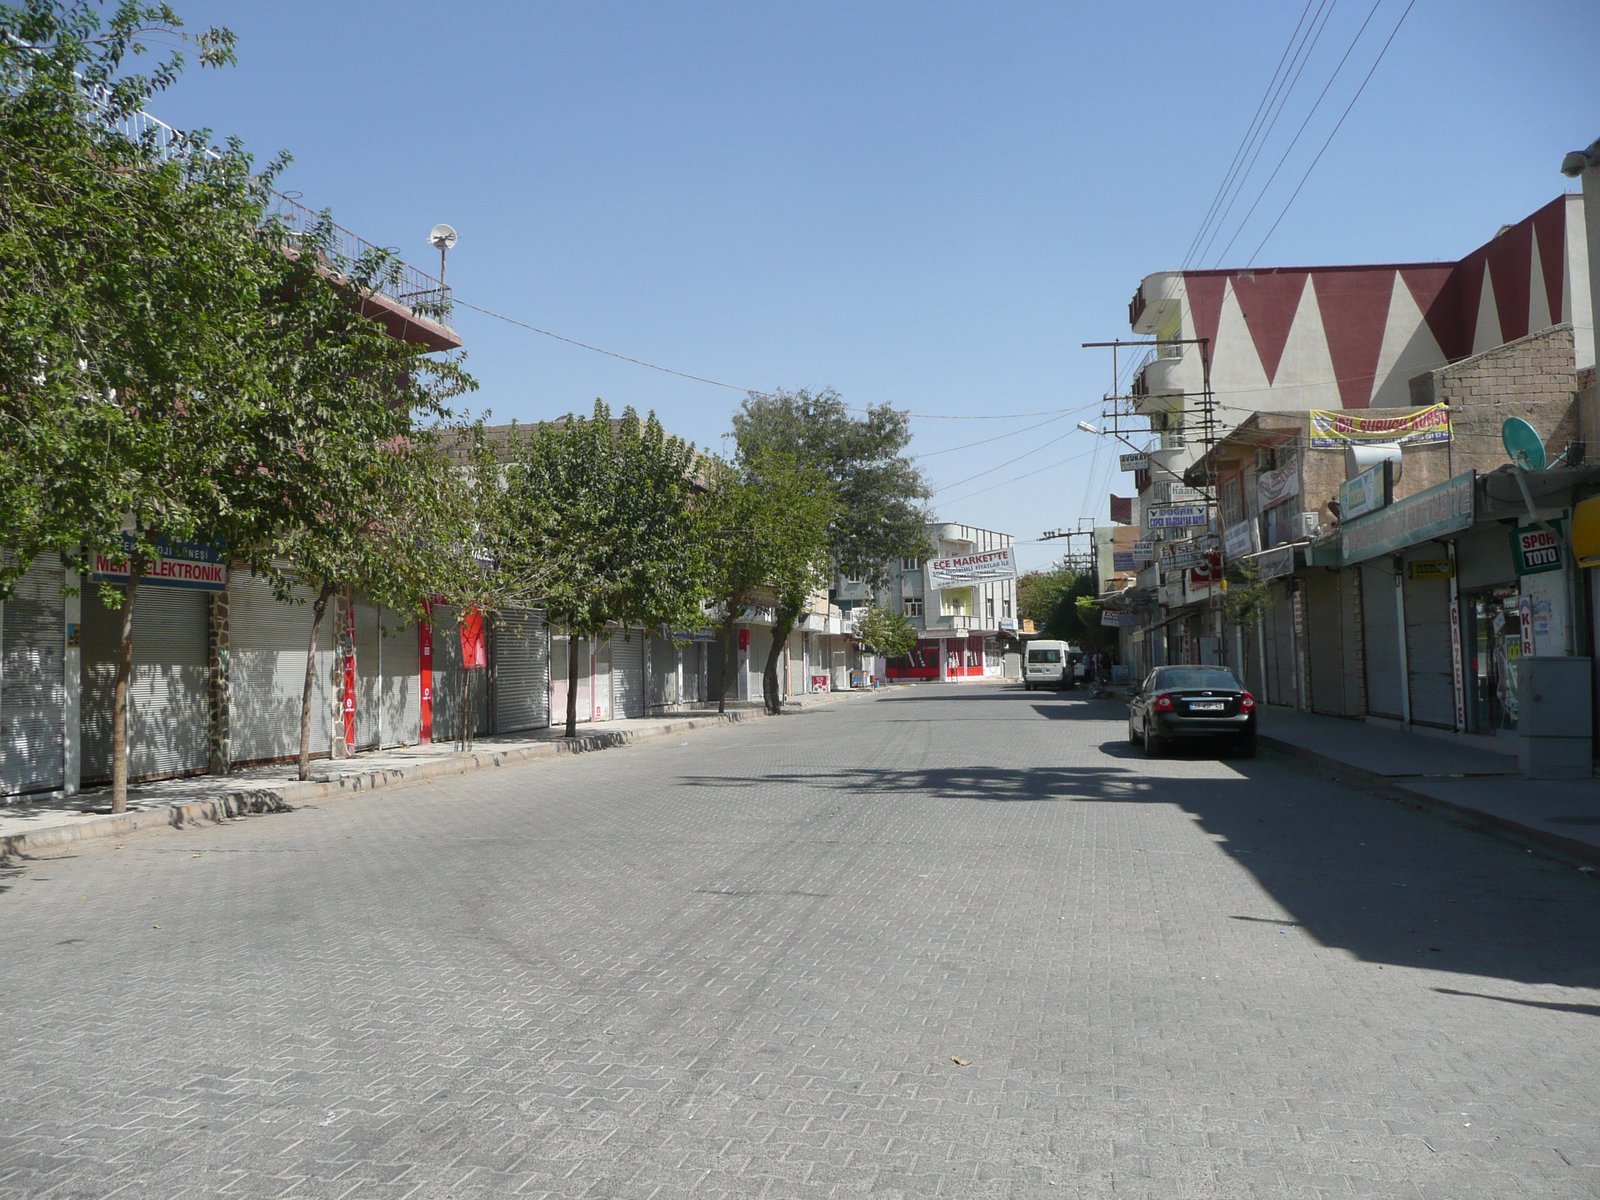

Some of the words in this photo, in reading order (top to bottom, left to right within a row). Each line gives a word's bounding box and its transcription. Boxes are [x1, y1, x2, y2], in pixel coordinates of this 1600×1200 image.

[933, 560, 951, 570] ECE
[1525, 548, 1557, 566] TOTO
[1451, 608, 1464, 724] GAZETE
